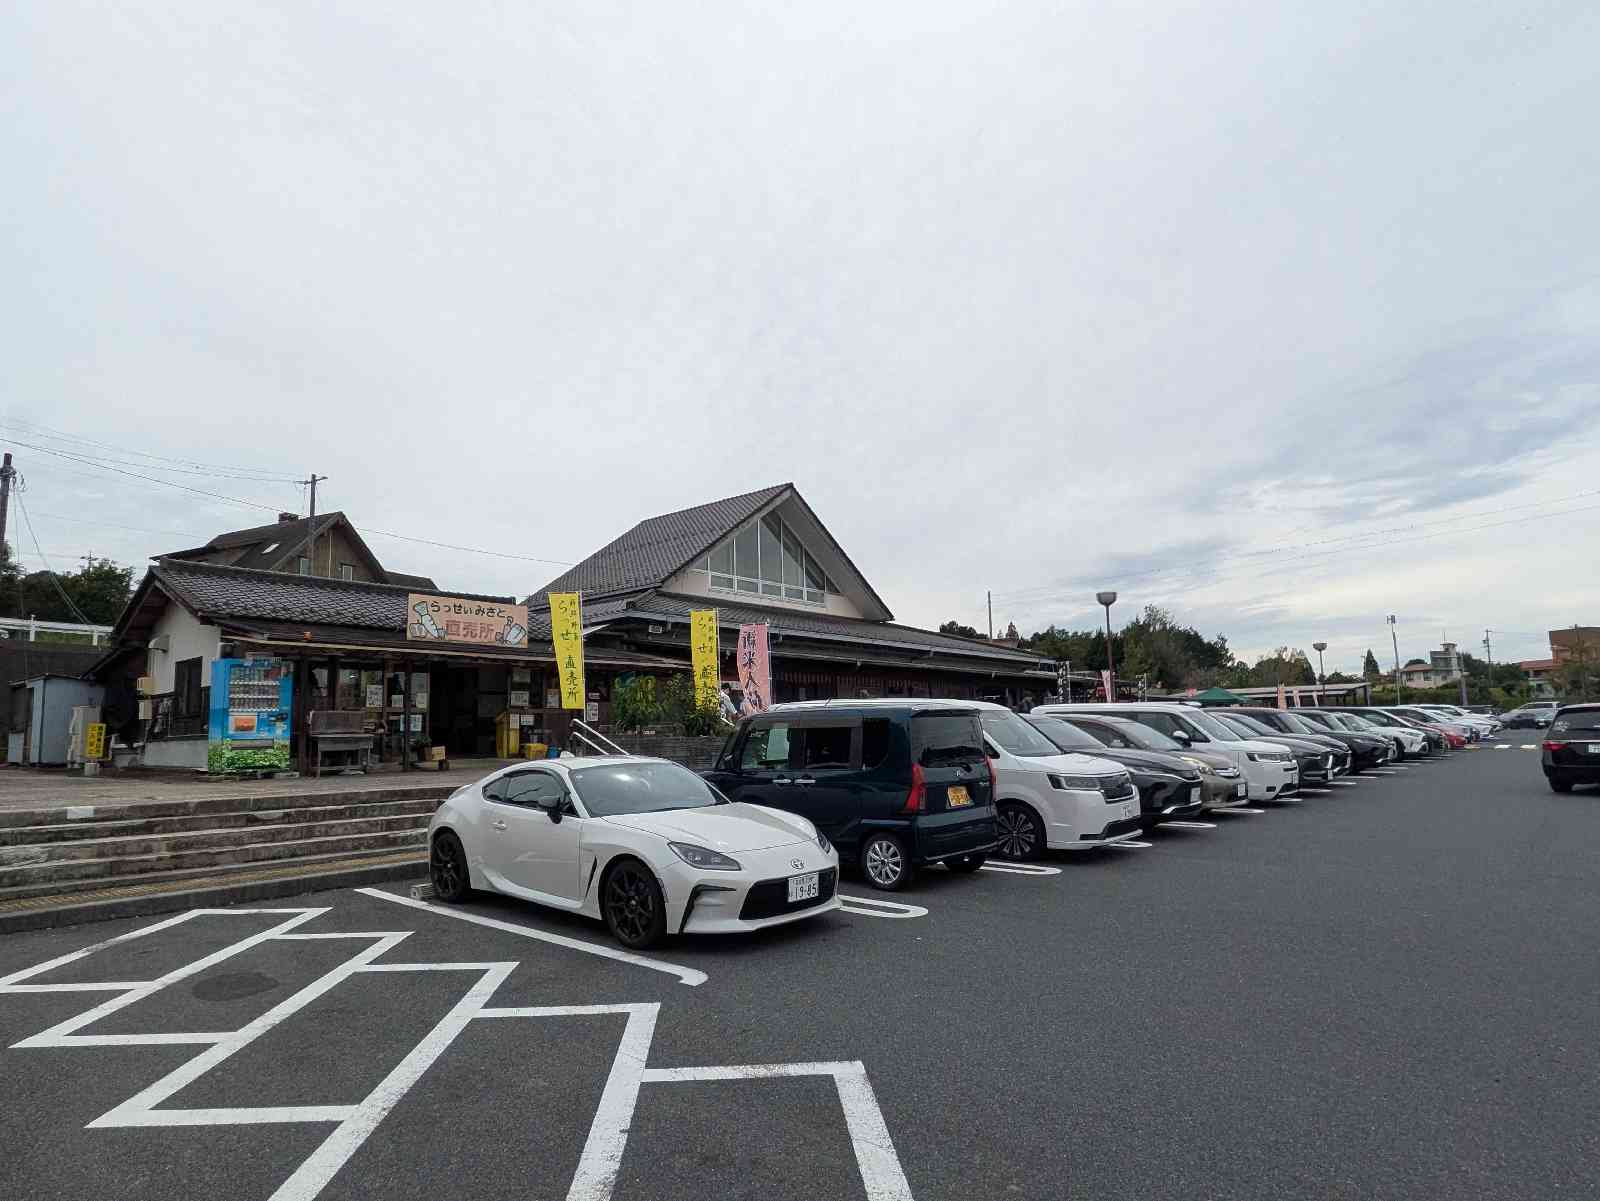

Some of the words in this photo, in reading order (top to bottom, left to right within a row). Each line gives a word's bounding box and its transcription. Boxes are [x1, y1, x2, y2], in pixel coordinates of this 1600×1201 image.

[430, 601, 506, 618] らっせいみさと
